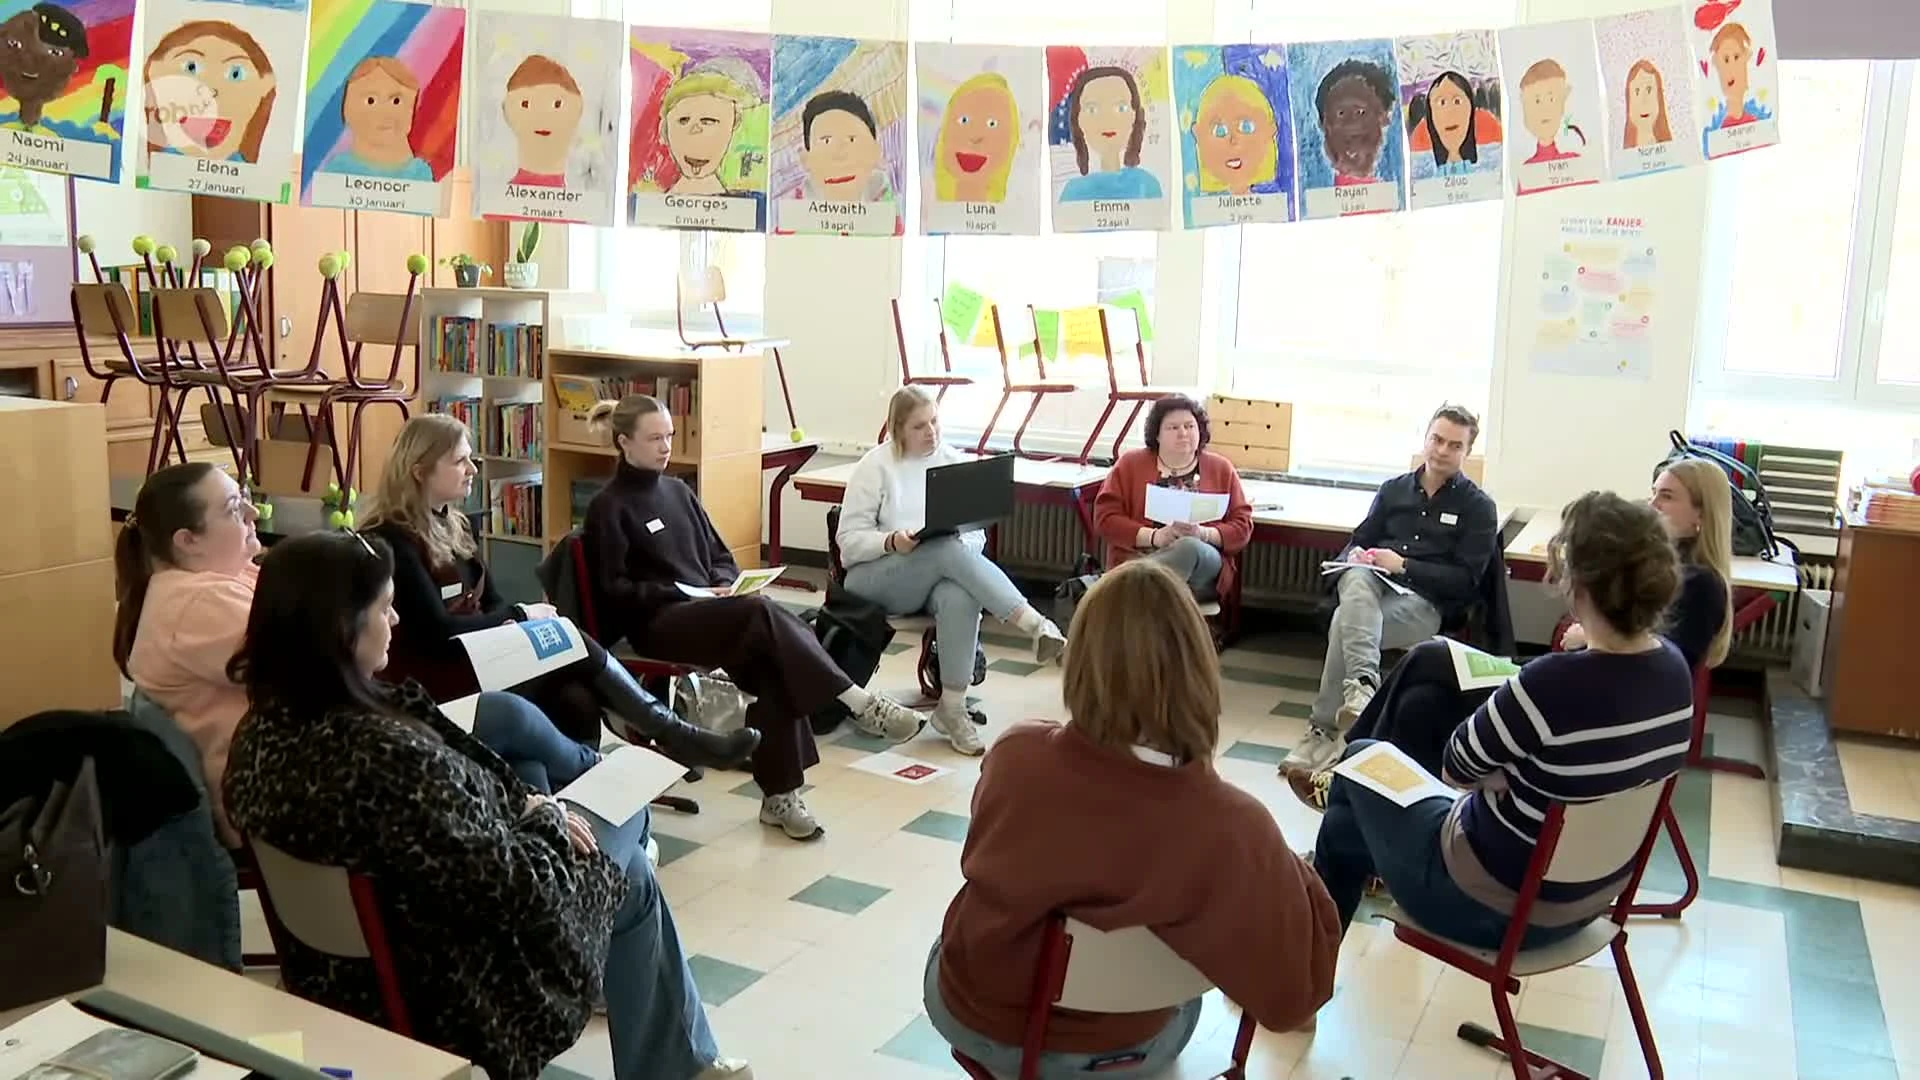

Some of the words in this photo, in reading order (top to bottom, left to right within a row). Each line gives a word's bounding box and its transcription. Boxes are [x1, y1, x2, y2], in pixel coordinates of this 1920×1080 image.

[12, 131, 64, 152] Naomi
[7, 151, 22, 163] 24
[25, 154, 69, 171] januari
[197, 159, 239, 177] Elena
[1548, 161, 1568, 173] Ivan
[187, 178, 201, 190] 27
[204, 181, 246, 195] januari
[345, 175, 410, 193] Leonoor
[505, 184, 582, 201] Alexander
[1334, 186, 1368, 201] Rayan
[365, 198, 405, 209] januari
[664, 194, 728, 212] Georges
[808, 200, 867, 215] Adwaith
[966, 202, 996, 215] Luna
[1093, 200, 1130, 213] Emma
[1218, 195, 1262, 209] Juliette
[522, 206, 529, 216] 2
[530, 207, 564, 218] maart
[683, 215, 716, 226] maart
[831, 220, 855, 232] april
[975, 220, 997, 232] april
